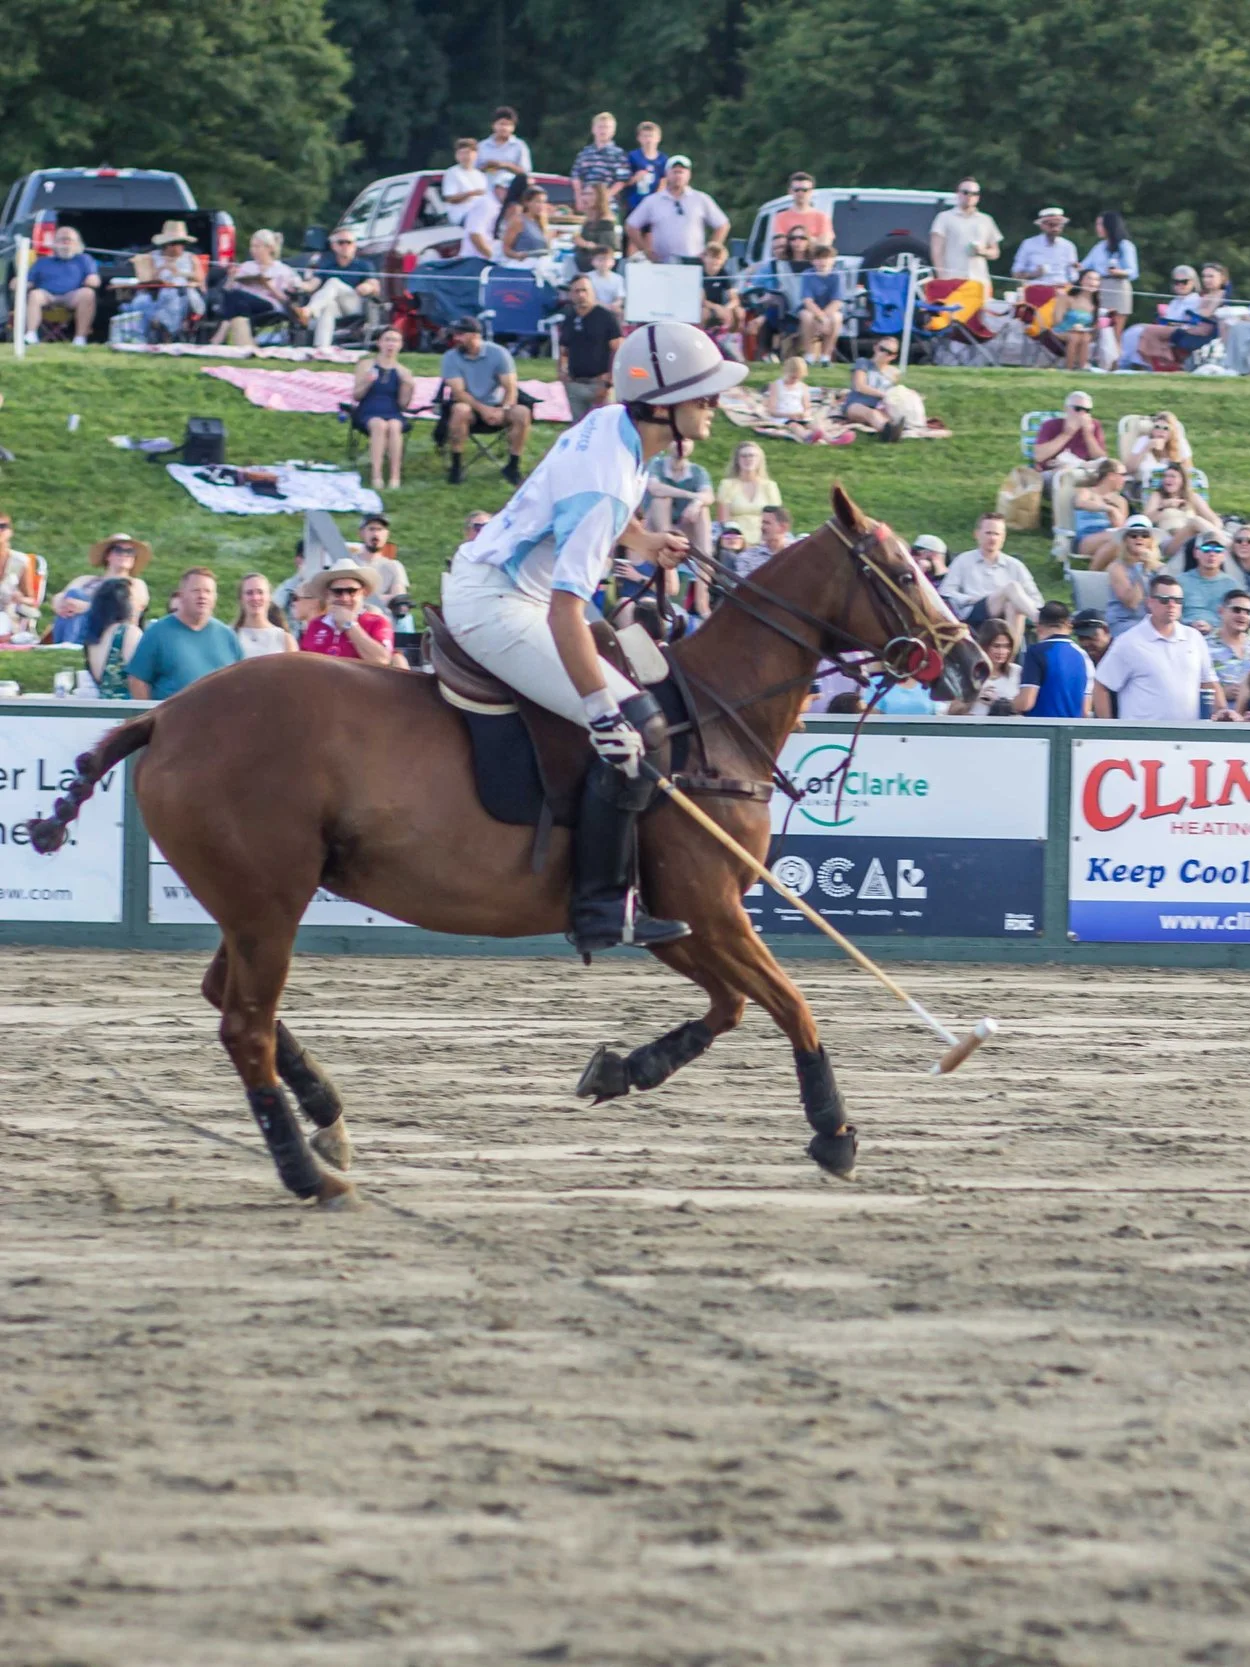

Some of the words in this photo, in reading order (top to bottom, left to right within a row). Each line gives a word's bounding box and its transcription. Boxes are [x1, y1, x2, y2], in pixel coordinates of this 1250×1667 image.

[843, 771, 929, 797] Clarke
[1086, 857, 1165, 889] Keep
[1180, 858, 1250, 885] Cool
